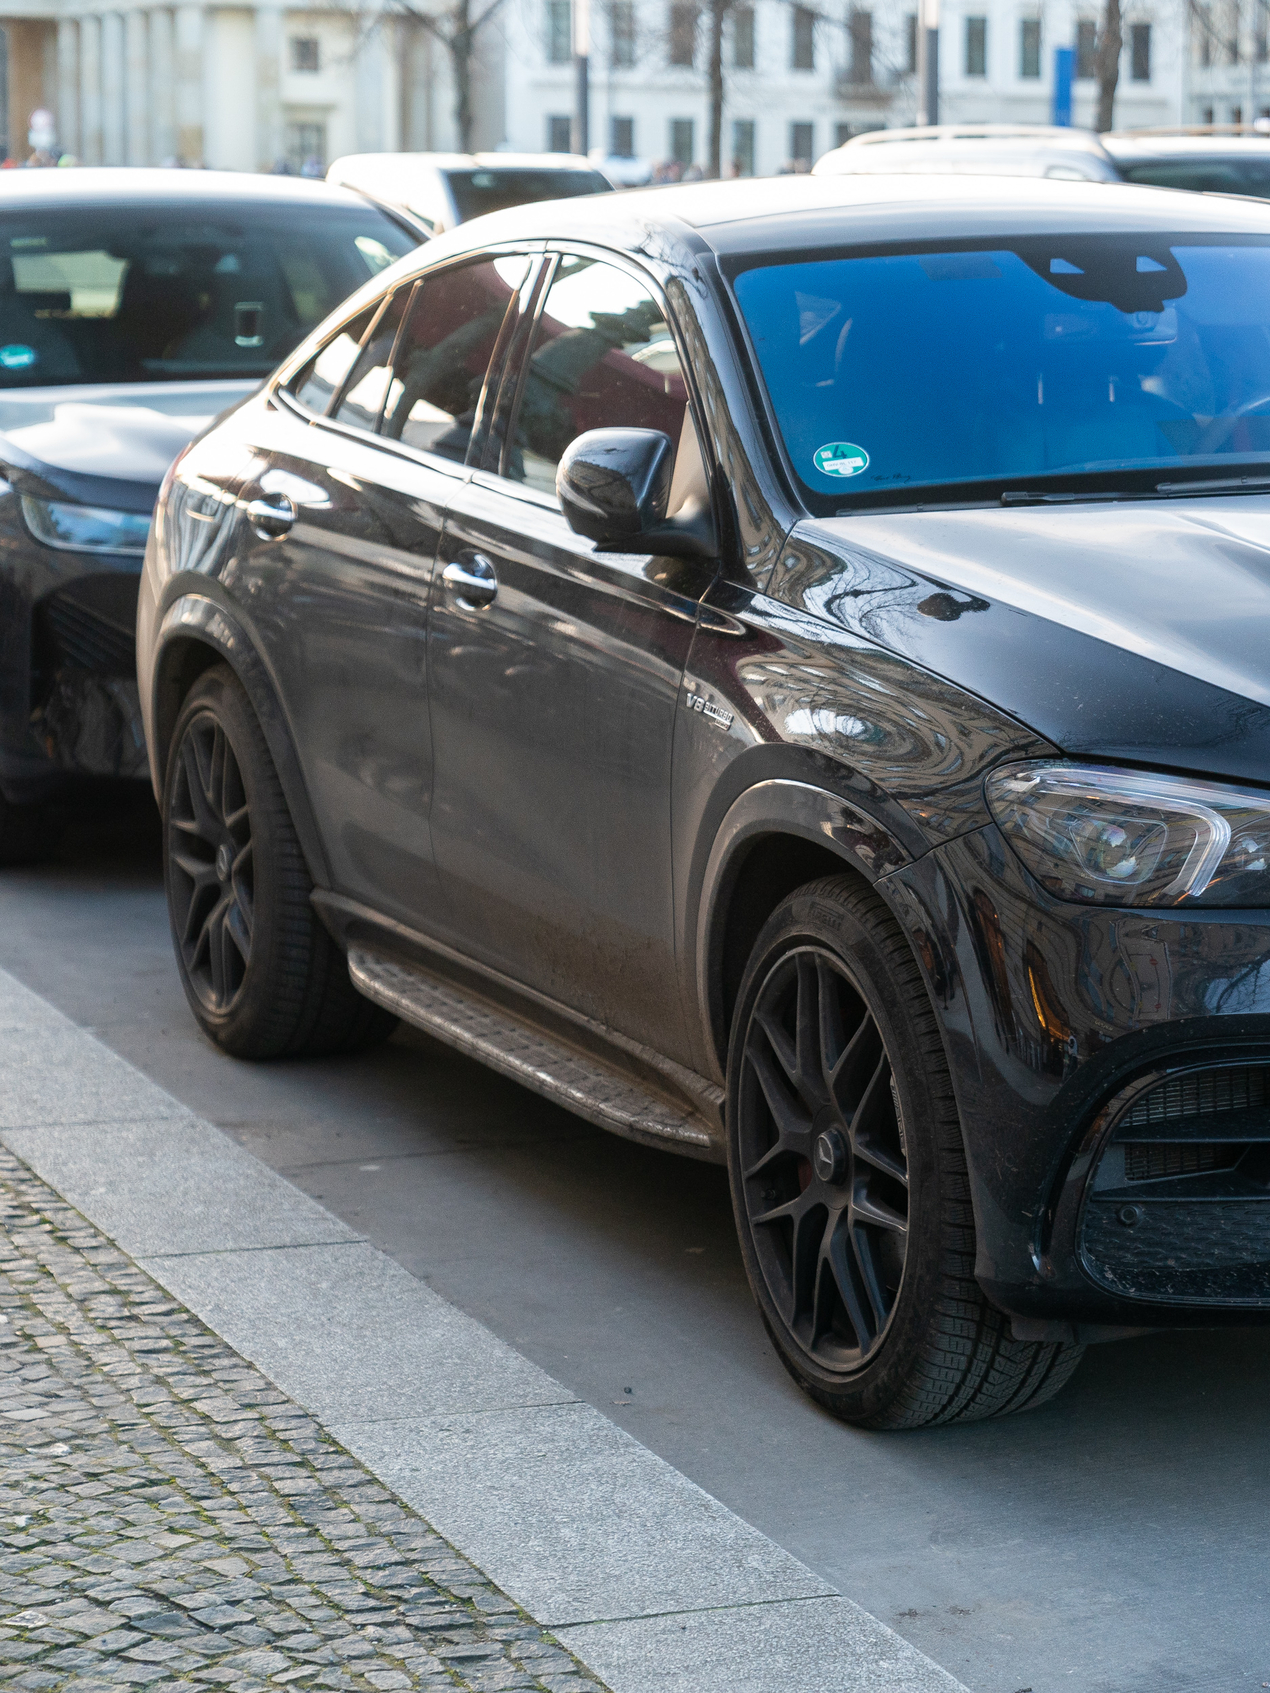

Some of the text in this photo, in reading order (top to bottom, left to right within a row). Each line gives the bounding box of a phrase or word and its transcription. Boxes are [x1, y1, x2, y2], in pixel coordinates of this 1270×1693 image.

[833, 445, 847, 459] 4
[686, 692, 733, 722] V8 BITURBO
